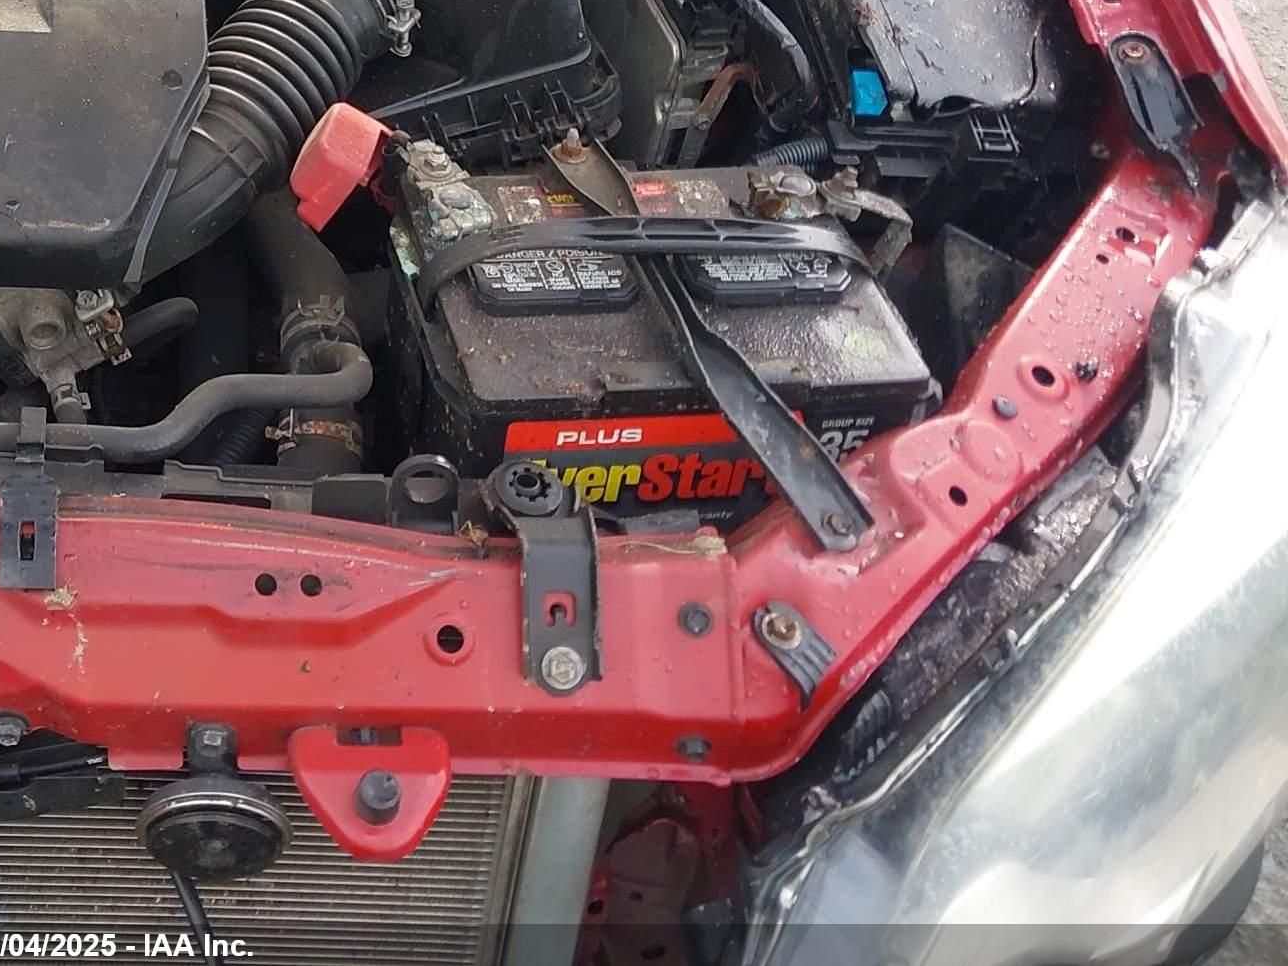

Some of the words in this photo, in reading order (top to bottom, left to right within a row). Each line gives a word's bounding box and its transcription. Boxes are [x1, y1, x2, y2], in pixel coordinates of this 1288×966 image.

[821, 418, 854, 429] GROUP
[855, 417, 875, 427] SIZE
[555, 427, 643, 446] PLUS
